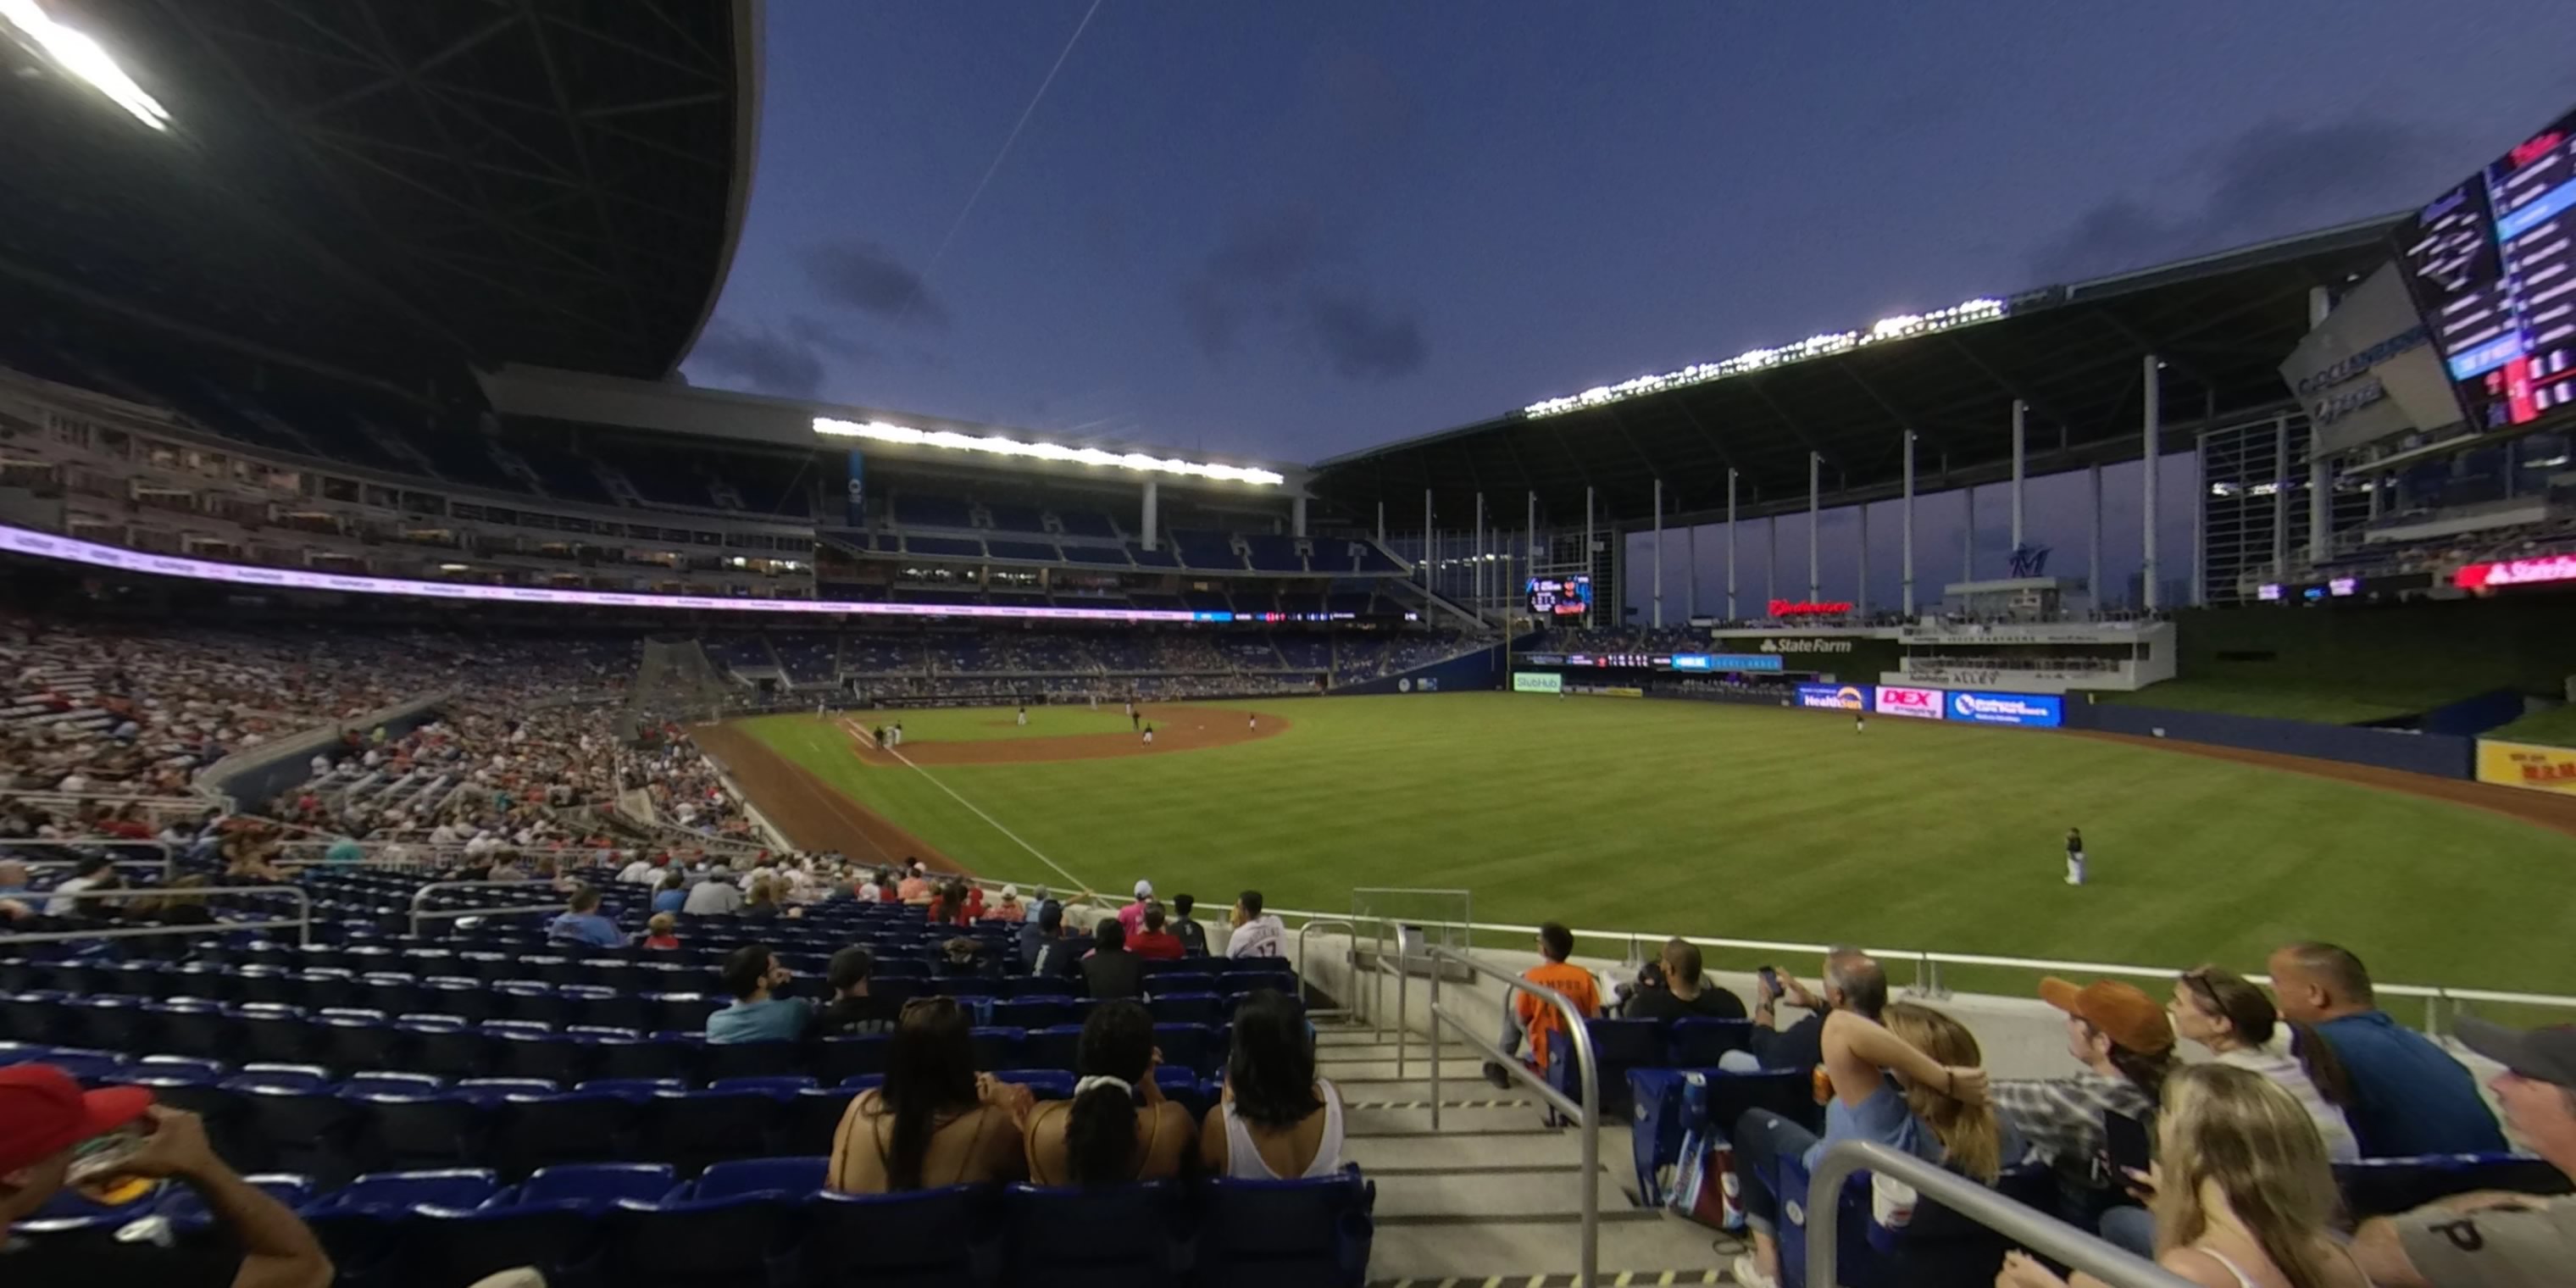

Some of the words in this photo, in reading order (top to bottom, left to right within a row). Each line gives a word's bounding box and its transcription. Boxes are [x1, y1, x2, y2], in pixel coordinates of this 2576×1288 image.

[1517, 678, 1557, 688] StubHub
[1884, 690, 1930, 706] DEX
[2429, 1219, 2483, 1252] P
